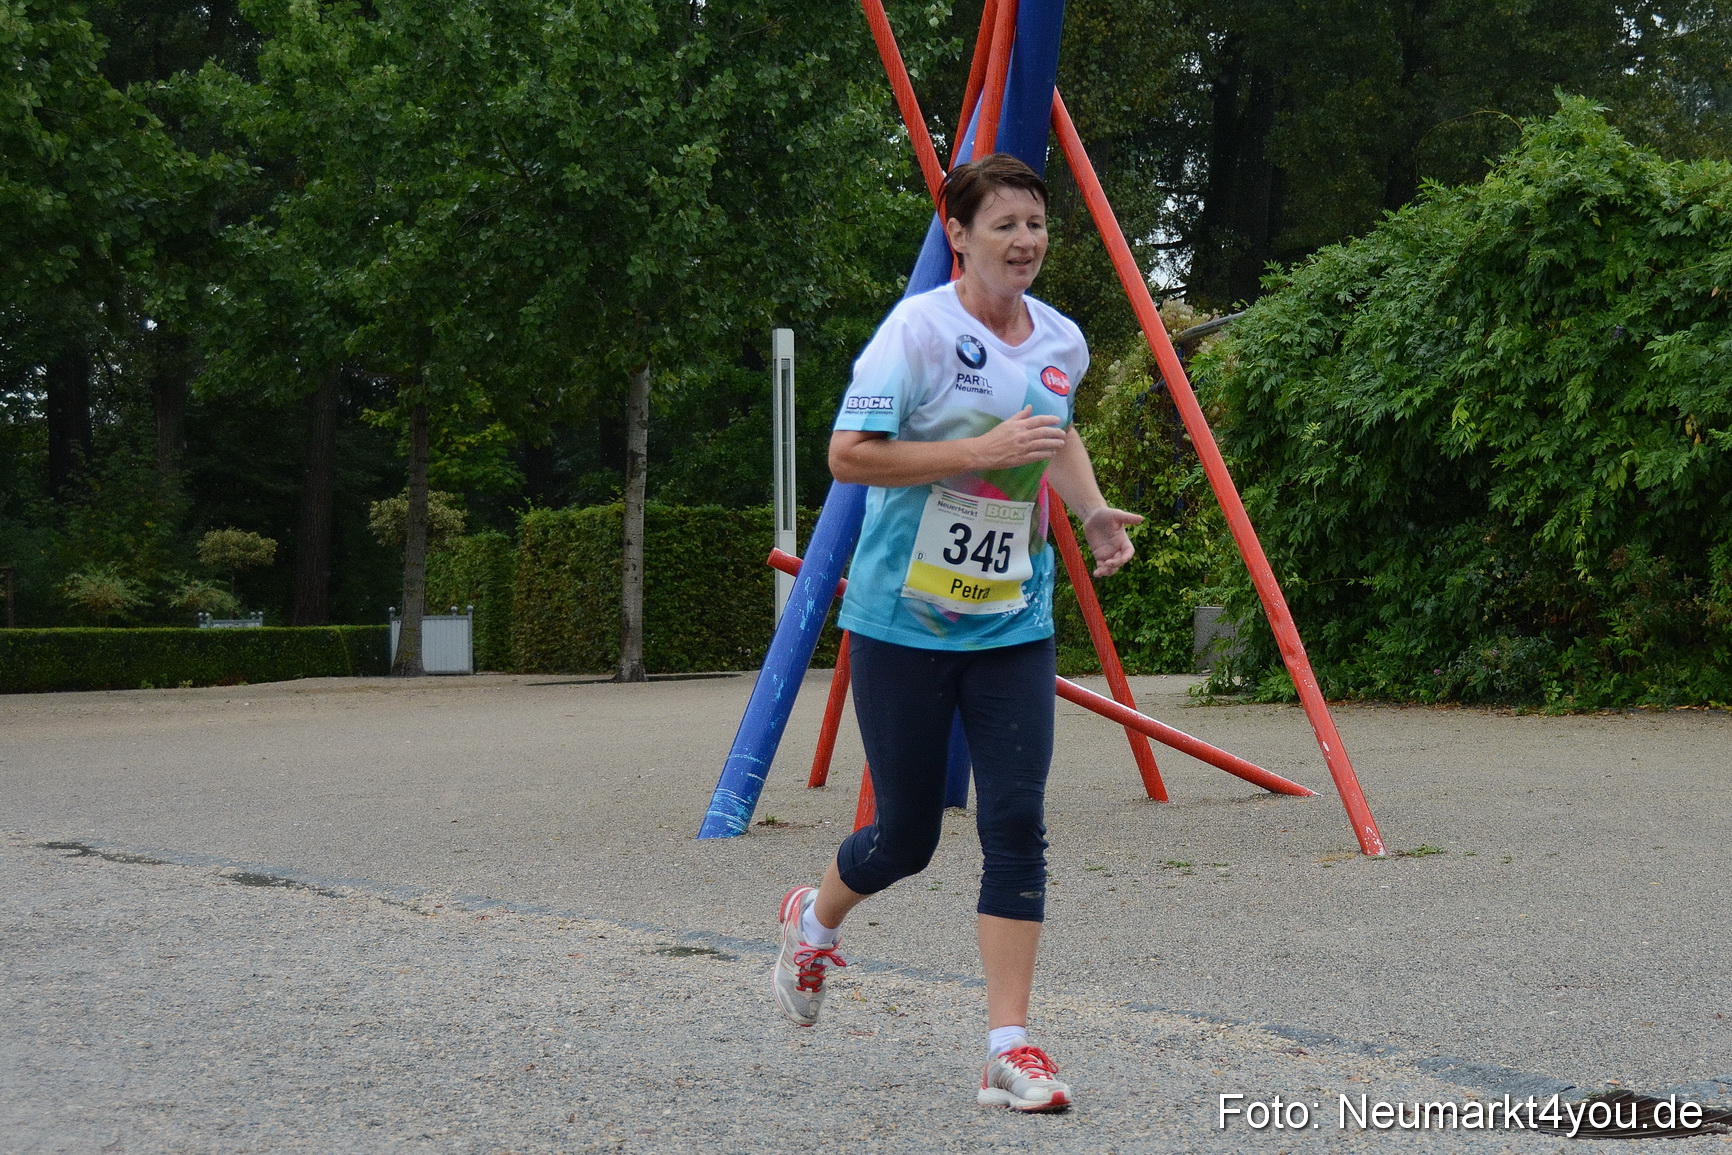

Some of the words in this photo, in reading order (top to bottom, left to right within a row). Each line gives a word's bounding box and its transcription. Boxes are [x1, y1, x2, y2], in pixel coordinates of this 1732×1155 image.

[956, 372, 993, 389] PARTL
[955, 383, 994, 396] Neumarkt
[846, 396, 894, 410] BOCK
[937, 500, 978, 517] NeuerMarkt
[942, 522, 1014, 574] 345
[950, 578, 991, 600] Petra
